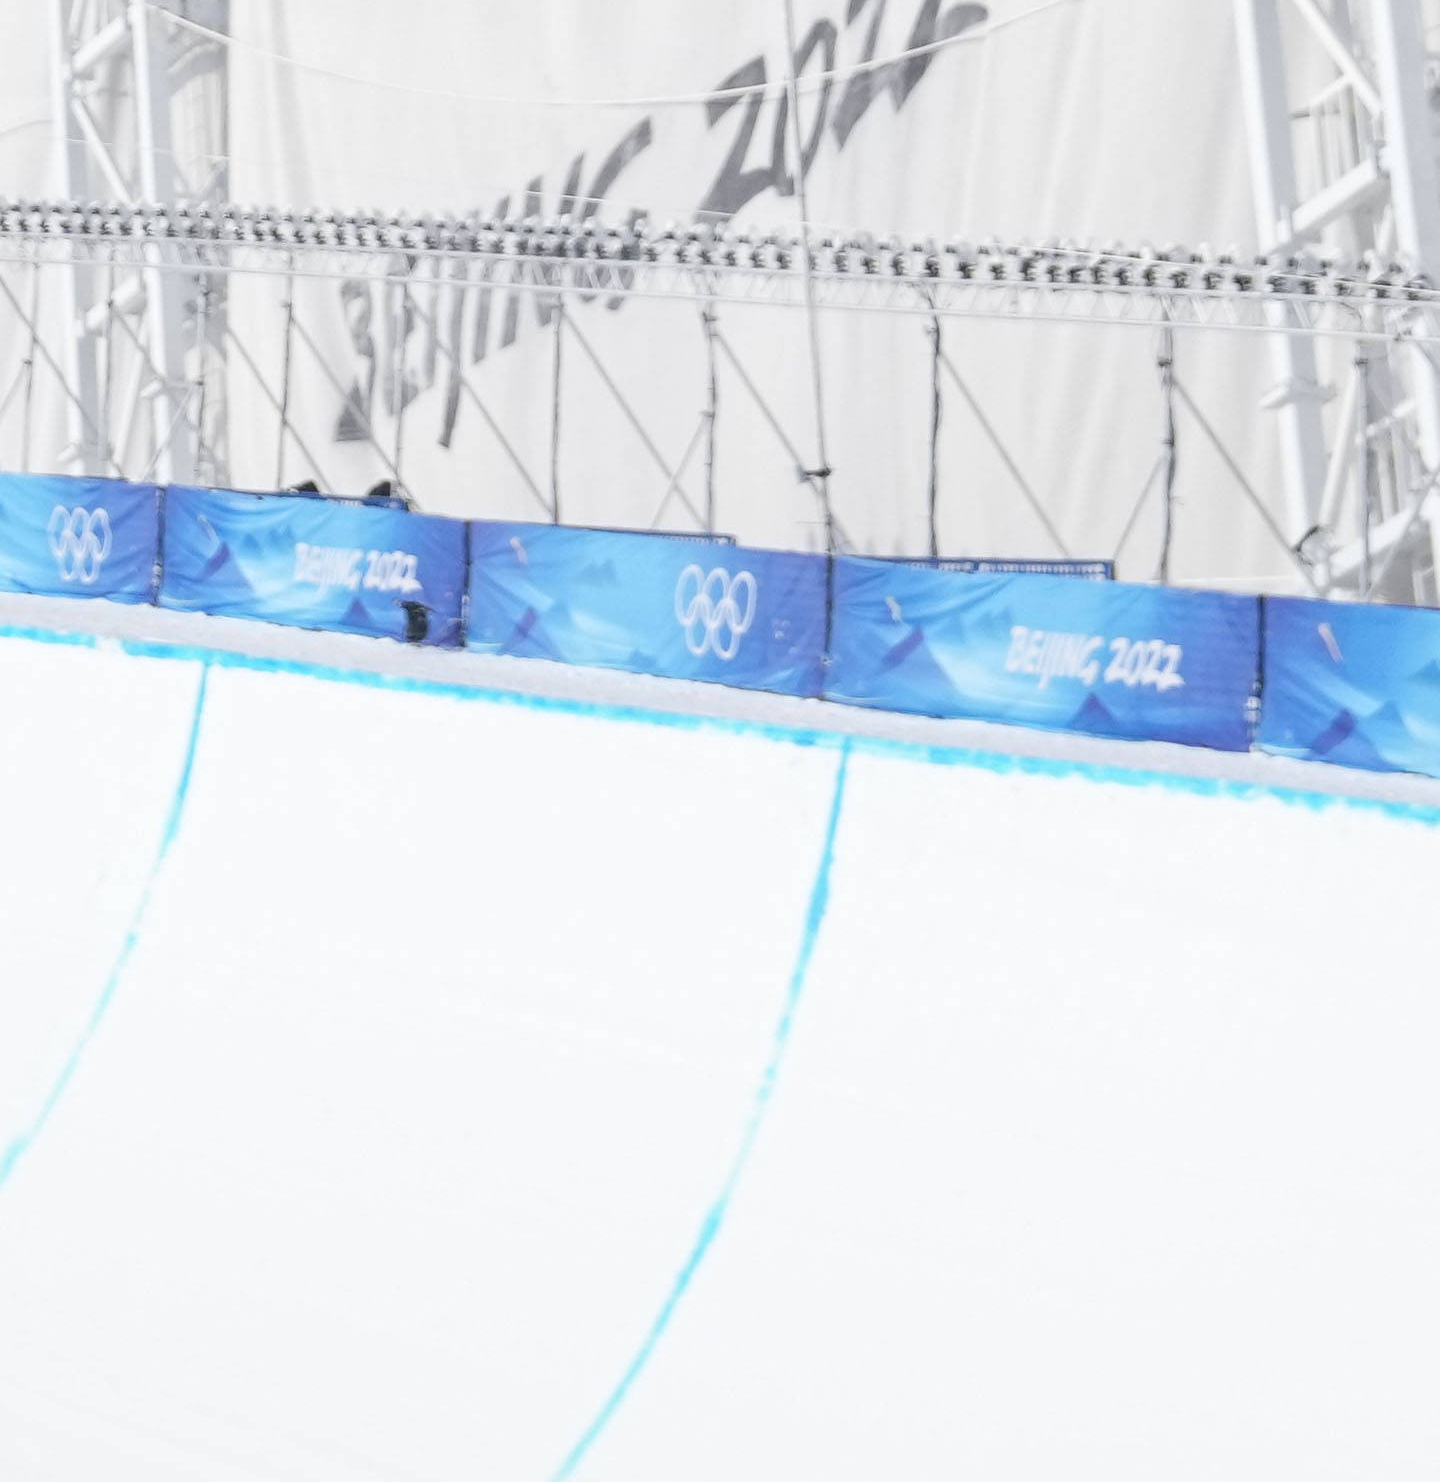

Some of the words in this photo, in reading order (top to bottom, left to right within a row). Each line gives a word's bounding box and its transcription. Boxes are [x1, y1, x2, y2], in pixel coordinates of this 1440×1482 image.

[363, 549, 424, 594] 2022
[1005, 625, 1105, 690] BEIJING
[1104, 637, 1186, 692] 2022
